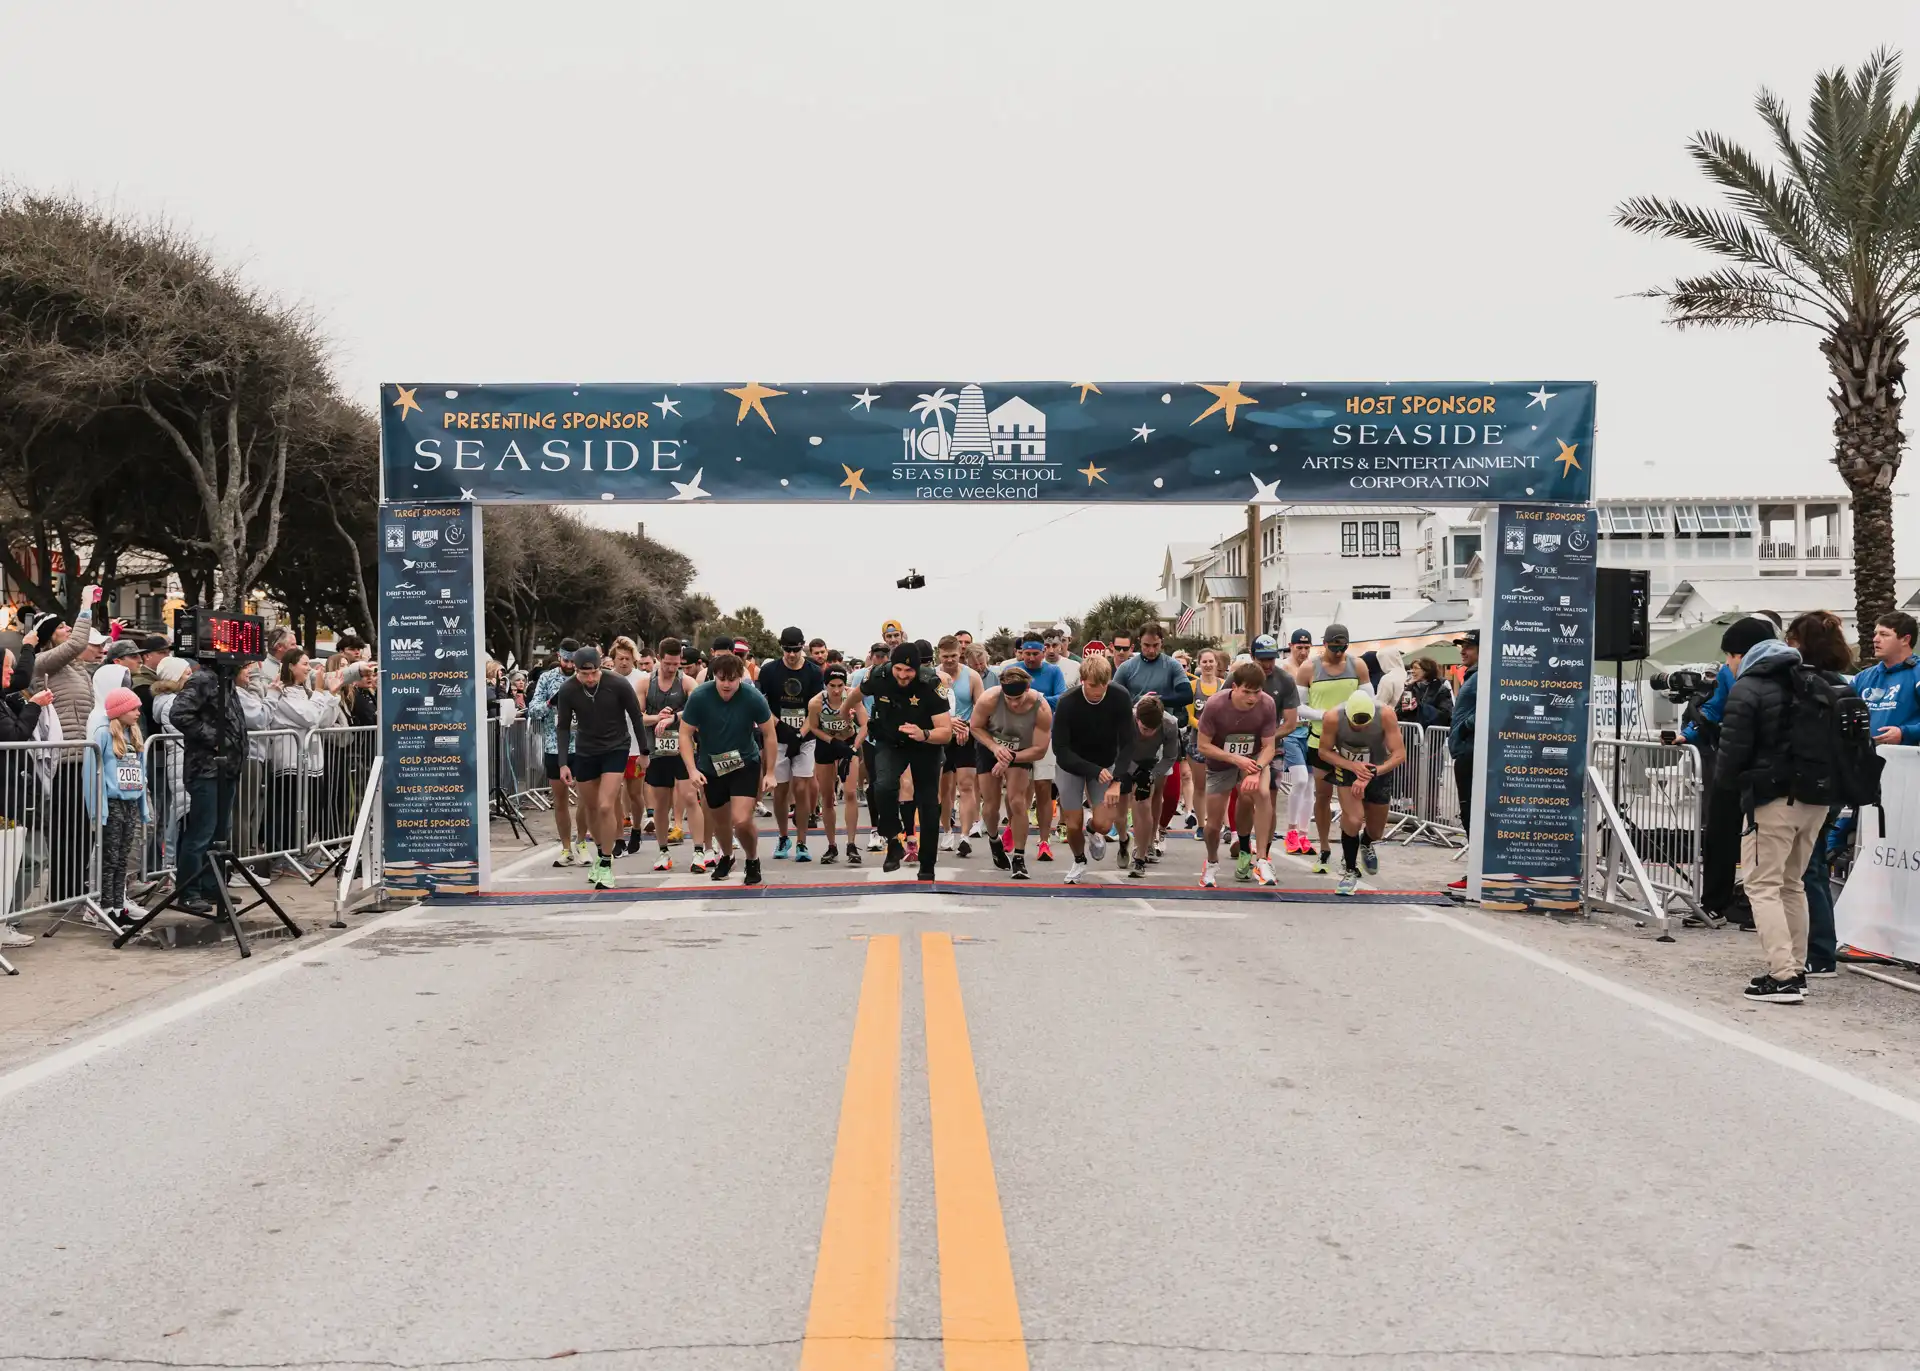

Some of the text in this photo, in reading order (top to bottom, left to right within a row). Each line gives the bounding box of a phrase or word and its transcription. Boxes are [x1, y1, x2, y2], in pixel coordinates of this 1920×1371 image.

[1346, 396, 1497, 415] HOST SPONSOR
[444, 411, 649, 430] PRESENTING SPONSOR
[1332, 424, 1504, 445] SEASIDE
[413, 439, 683, 472] SEASIDE
[958, 455, 984, 467] 2024
[1302, 456, 1539, 469] ARTS & ENTERTAINMENT
[892, 468, 1061, 480] SEASIDE SCHOOL
[1350, 475, 1489, 489] CORPORATION
[916, 483, 1038, 498] race weekend
[394, 509, 420, 517] TARGET
[1516, 511, 1585, 521] TARGET SPONSORS
[412, 530, 438, 541] GRAYTON
[1533, 534, 1561, 545] GRAYTON
[446, 649, 468, 658] pepsi
[429, 671, 468, 679] SPONSORS
[1500, 679, 1583, 689] DIAMOND SPONSORS
[1500, 694, 1530, 702] Publix
[1595, 689, 1636, 704] FTERNOON
[1499, 732, 1576, 742] PLATINUM SPONSORS
[660, 740, 675, 749] 343
[1230, 744, 1249, 753] 819
[1347, 752, 1364, 762] 174
[1504, 766, 1568, 776] GOLD SPONSORS
[1499, 796, 1569, 806] SILVER SPONSORS
[397, 819, 428, 828] BRONZE
[1497, 830, 1574, 841] BRONZE SPONSORS
